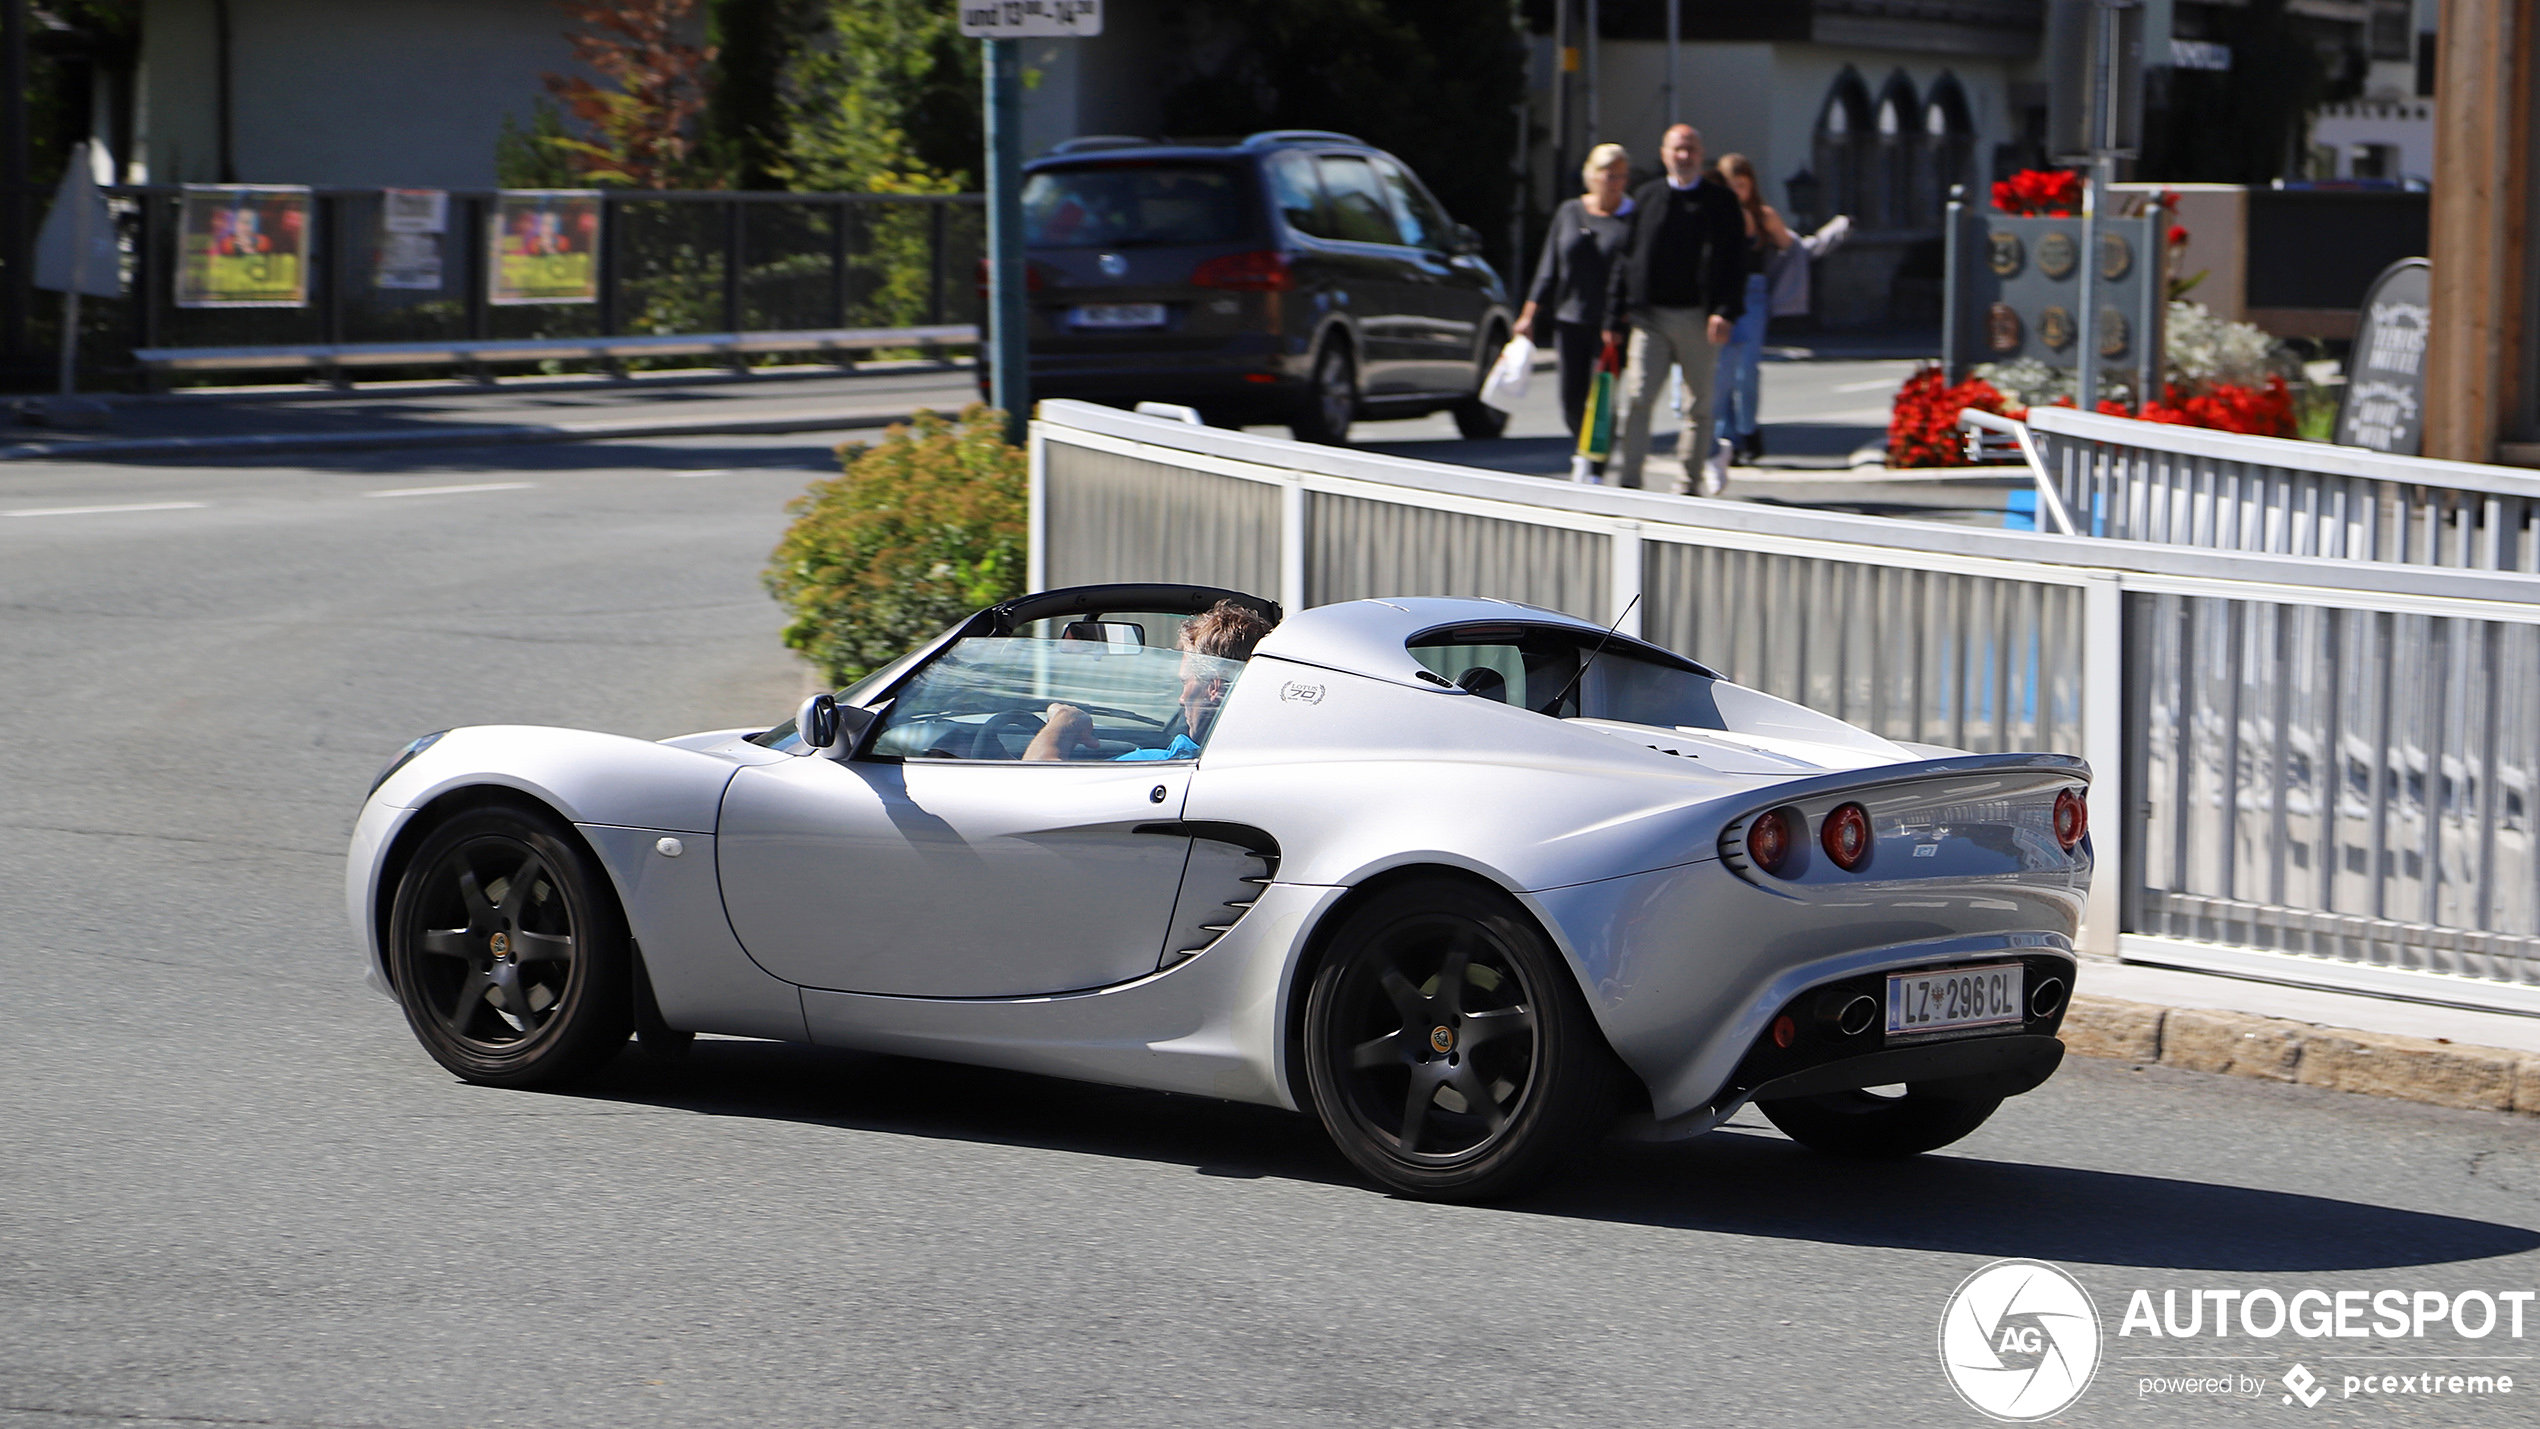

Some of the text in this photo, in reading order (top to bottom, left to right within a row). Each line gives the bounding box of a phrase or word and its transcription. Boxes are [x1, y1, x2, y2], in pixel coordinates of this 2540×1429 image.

[1291, 683, 1318, 691] LOTUS
[1290, 688, 1316, 699] 70
[1906, 973, 2013, 1023] LZ 296 CL
